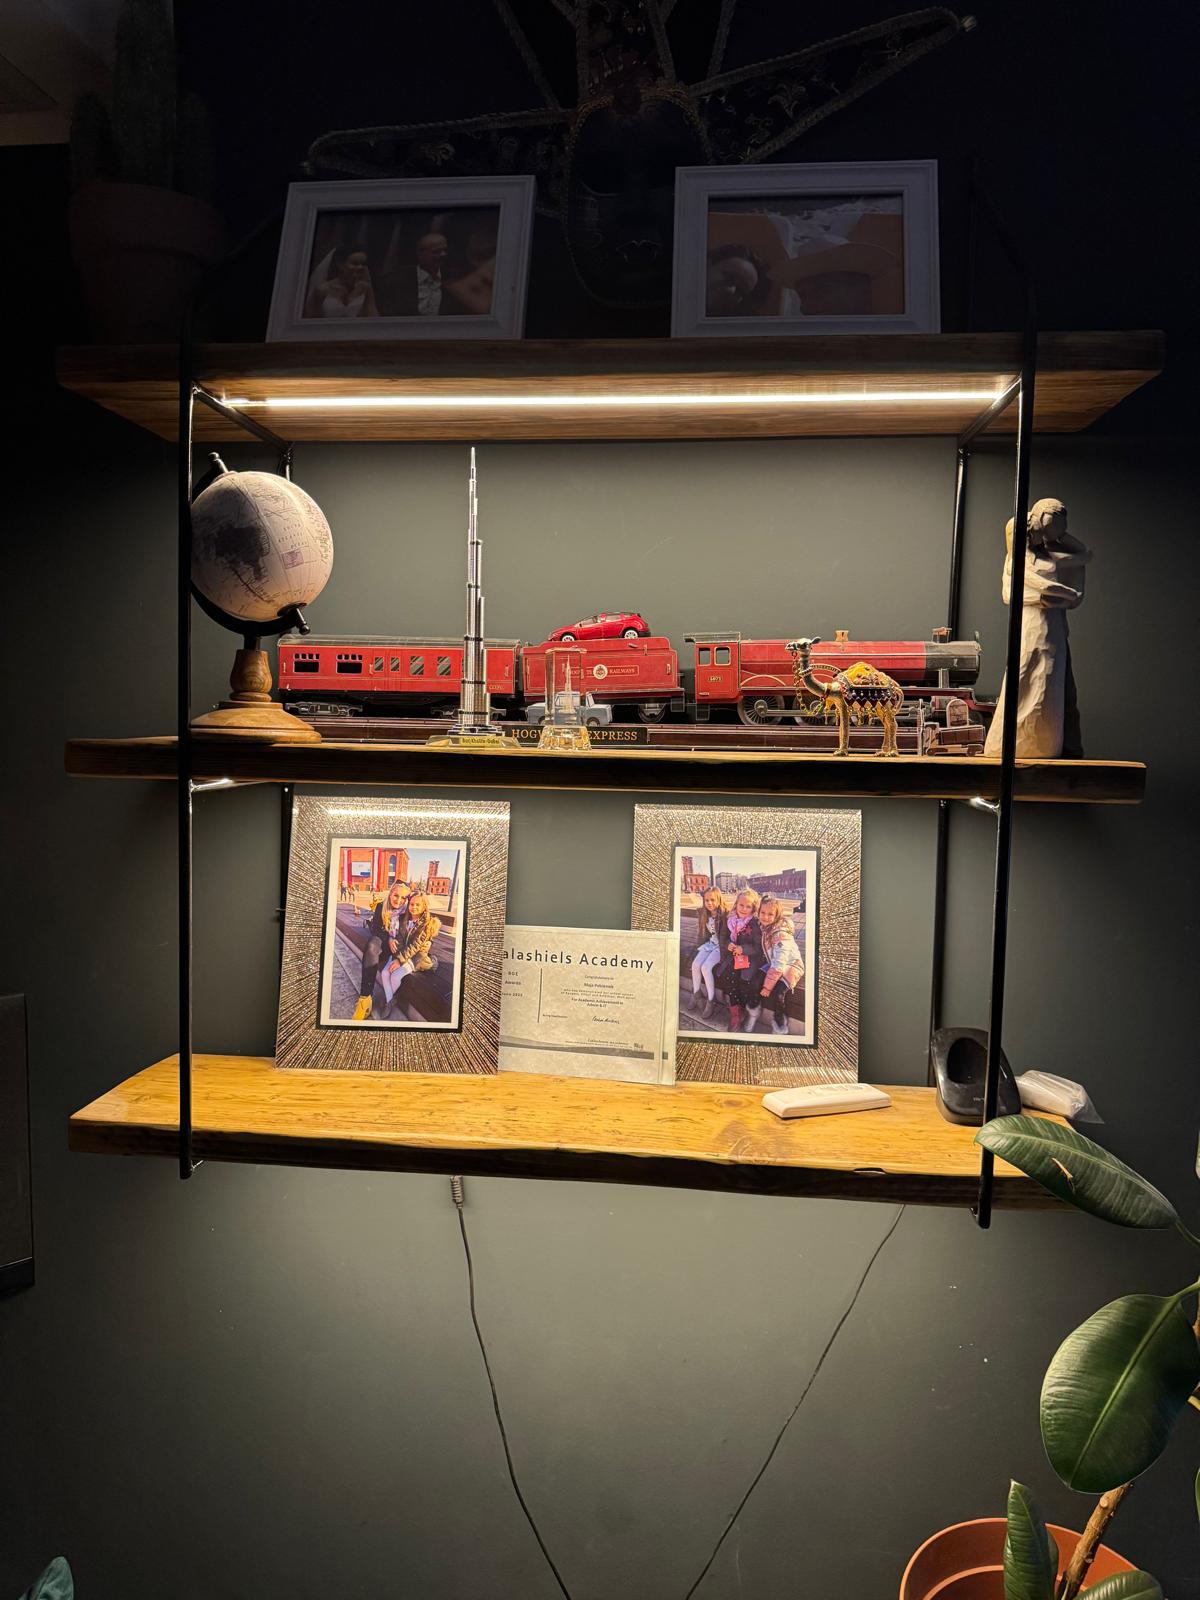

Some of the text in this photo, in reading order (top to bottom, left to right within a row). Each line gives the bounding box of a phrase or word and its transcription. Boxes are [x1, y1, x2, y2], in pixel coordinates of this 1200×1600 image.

[587, 730, 637, 740] EXPRESS
[502, 948, 654, 973] alashiels Academy
